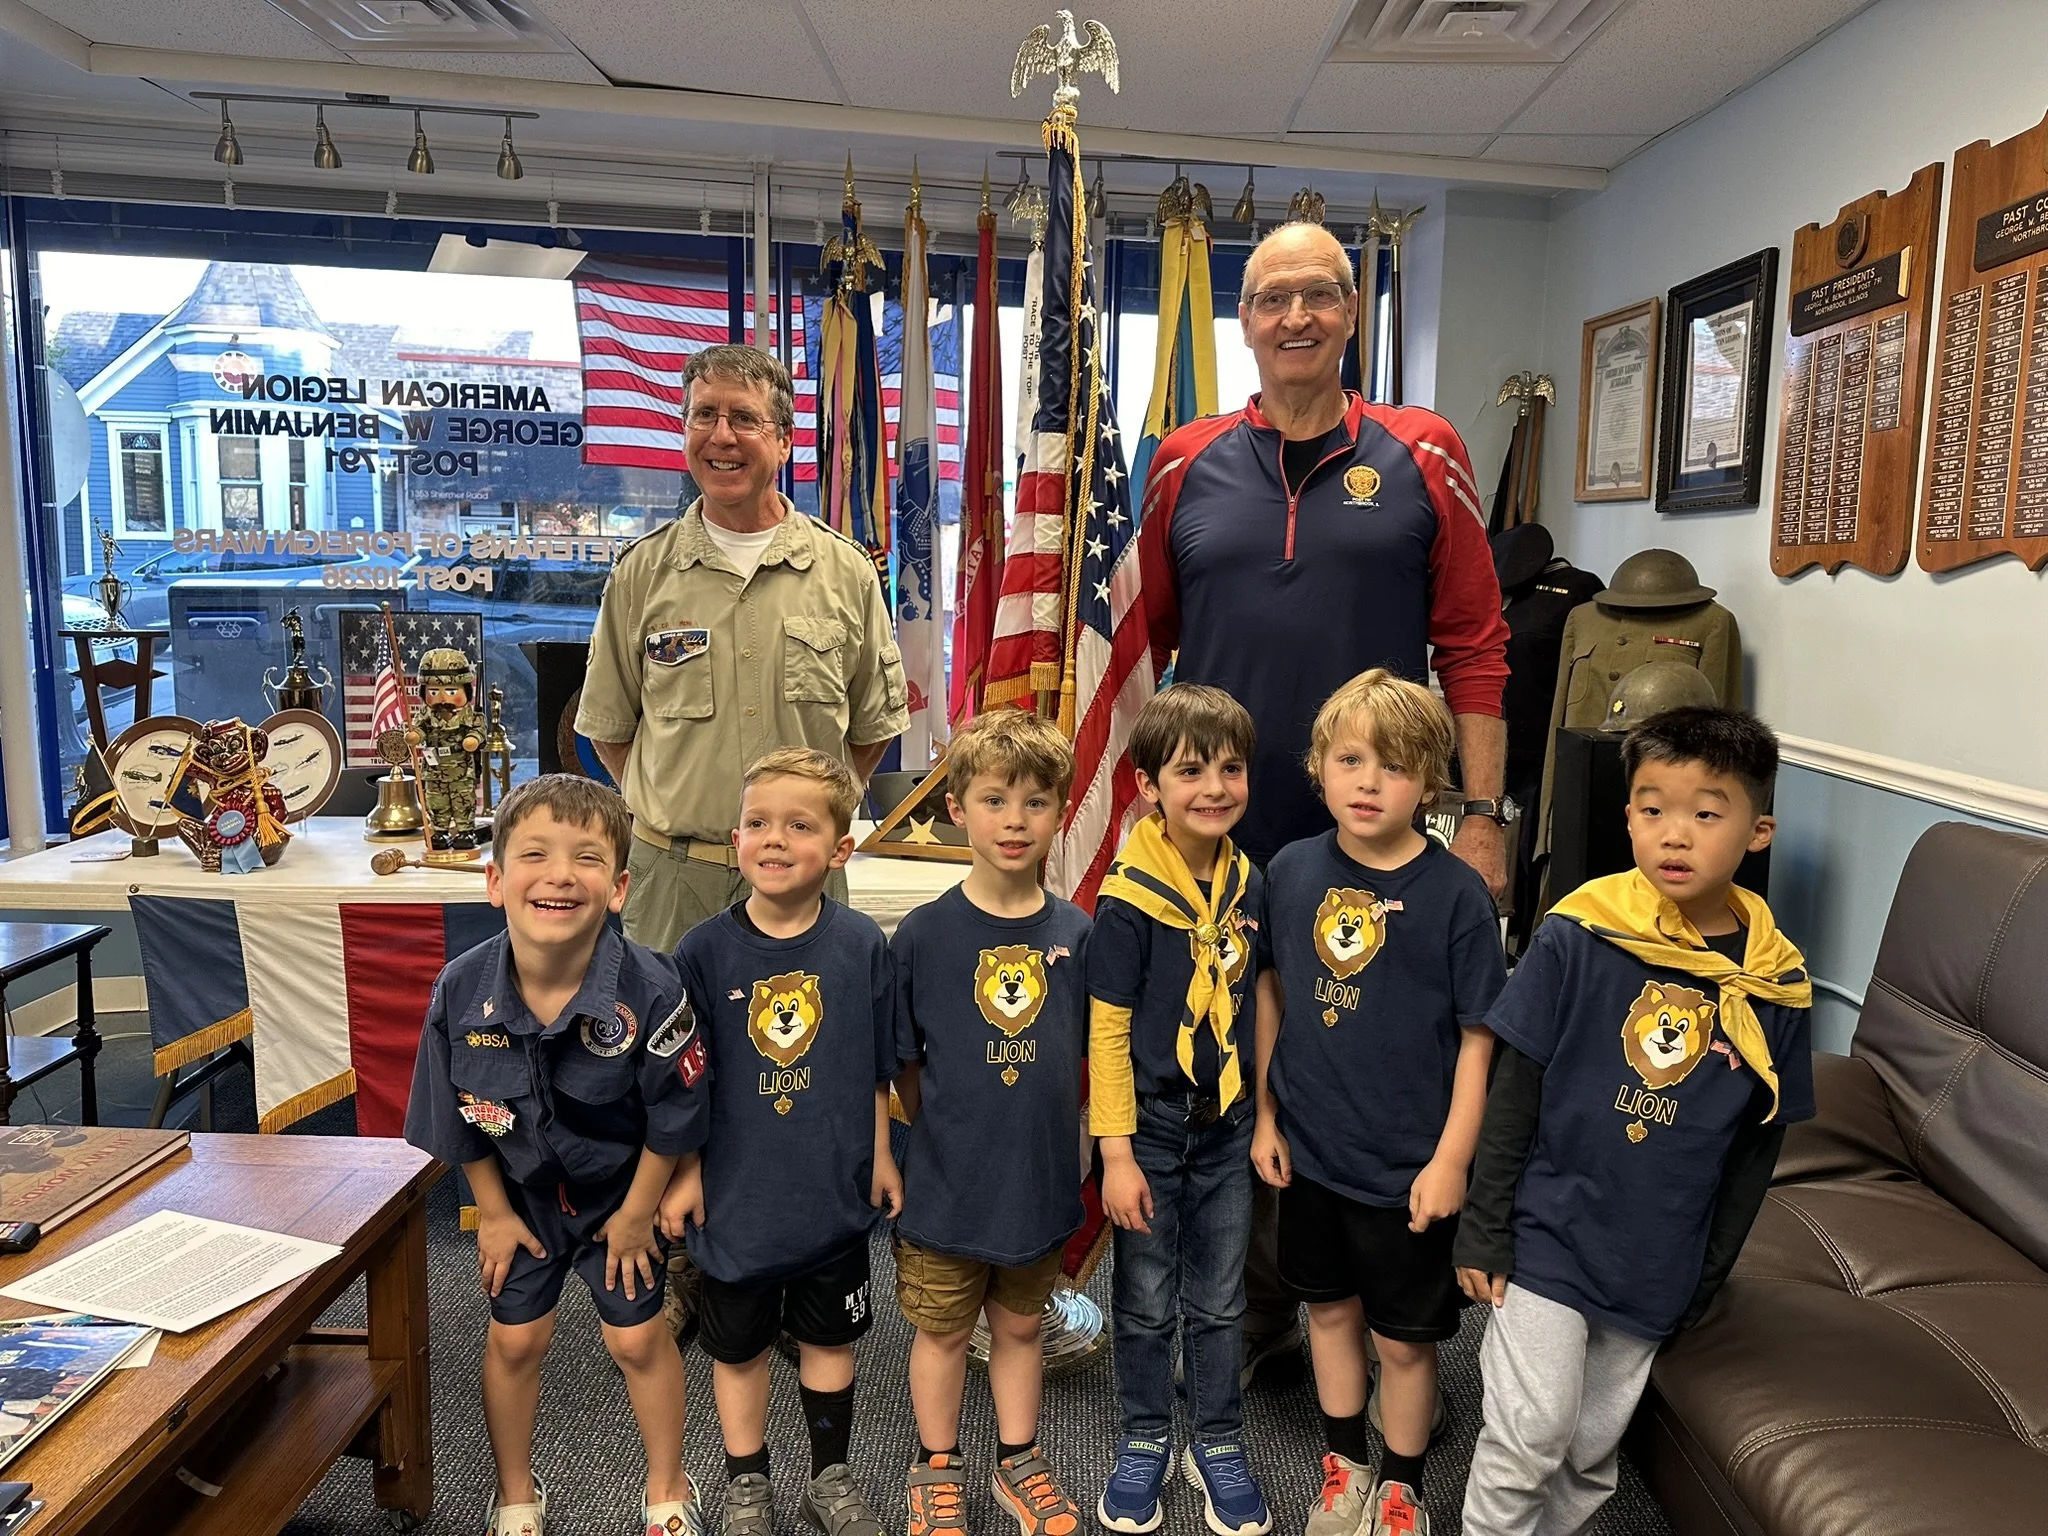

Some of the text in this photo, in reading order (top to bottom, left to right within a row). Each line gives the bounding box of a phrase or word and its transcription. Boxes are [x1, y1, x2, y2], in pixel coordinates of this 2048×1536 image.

[2003, 205, 2029, 226] PAST
[1995, 222, 2023, 239] GEORGE
[1811, 267, 1876, 301] PAST PRESIDENTS
[1804, 298, 1822, 312] GEORGE
[1832, 286, 1856, 301] BENJAMIN
[1858, 281, 1871, 291] POST
[1849, 291, 1869, 304] ILLINOIS
[1029, 333, 1035, 346] TO
[1435, 813, 1455, 845] MIA
[1314, 977, 1361, 1011] LION
[481, 1033, 510, 1048] BSA
[986, 1040, 1036, 1064] LION
[759, 1067, 811, 1095] LION
[463, 1104, 511, 1121] PINEWOOD
[1614, 1084, 1678, 1126] LION
[474, 1113, 503, 1123] DERBY
[9, 1168, 82, 1207] WORDS
[851, 1300, 865, 1323] 59
